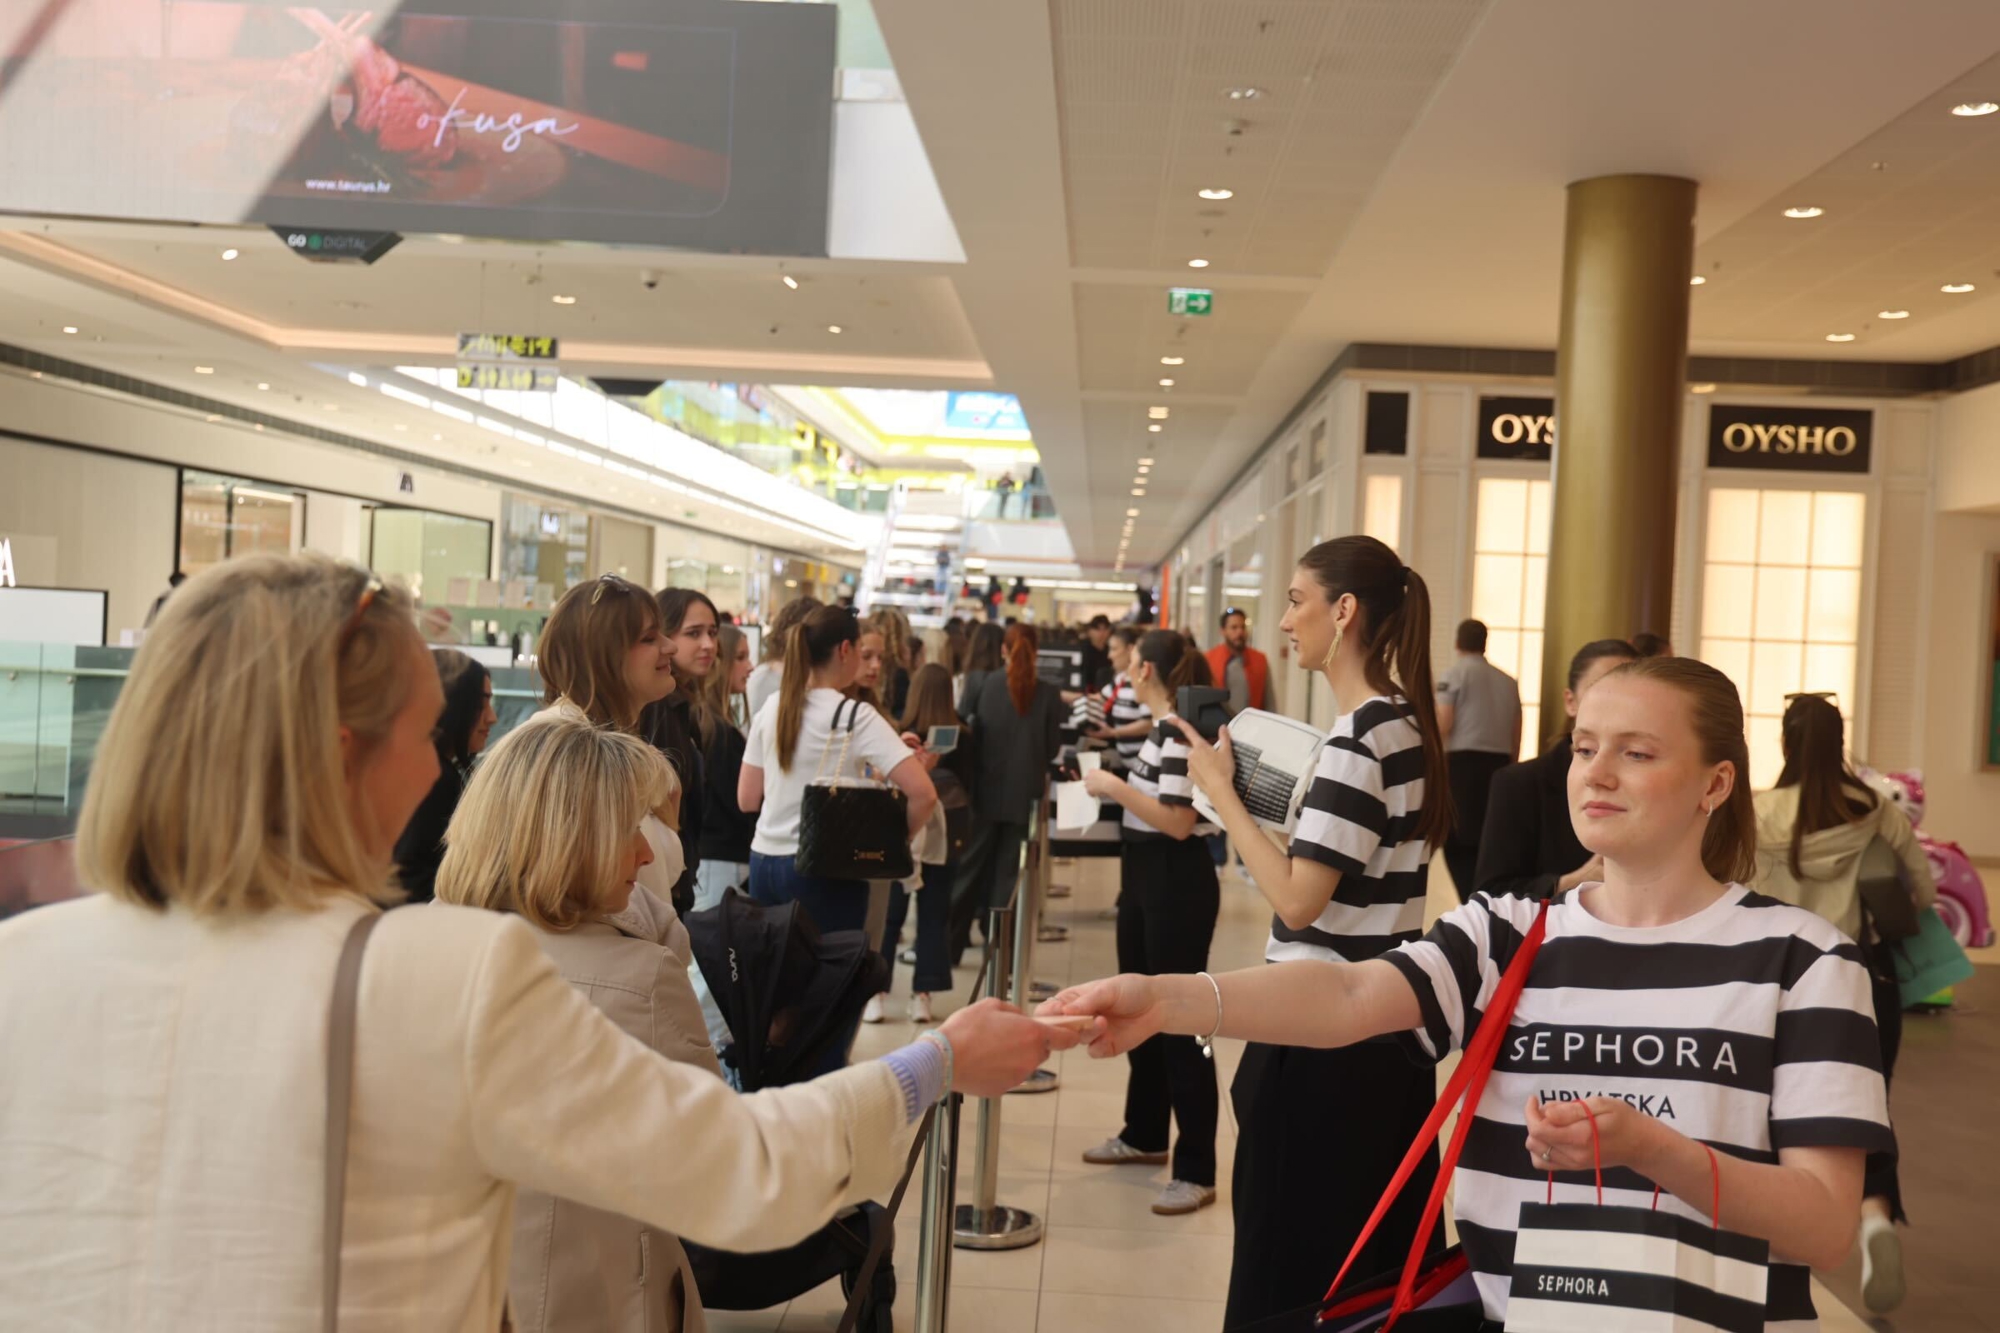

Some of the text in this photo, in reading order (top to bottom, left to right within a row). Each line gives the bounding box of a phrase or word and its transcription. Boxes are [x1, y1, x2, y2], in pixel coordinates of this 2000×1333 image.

[416, 86, 579, 152] okusa
[1722, 422, 1857, 456] OYSHO
[1510, 1032, 1738, 1075] SEPHORA
[1538, 1274, 1609, 1297] SEPHORA
